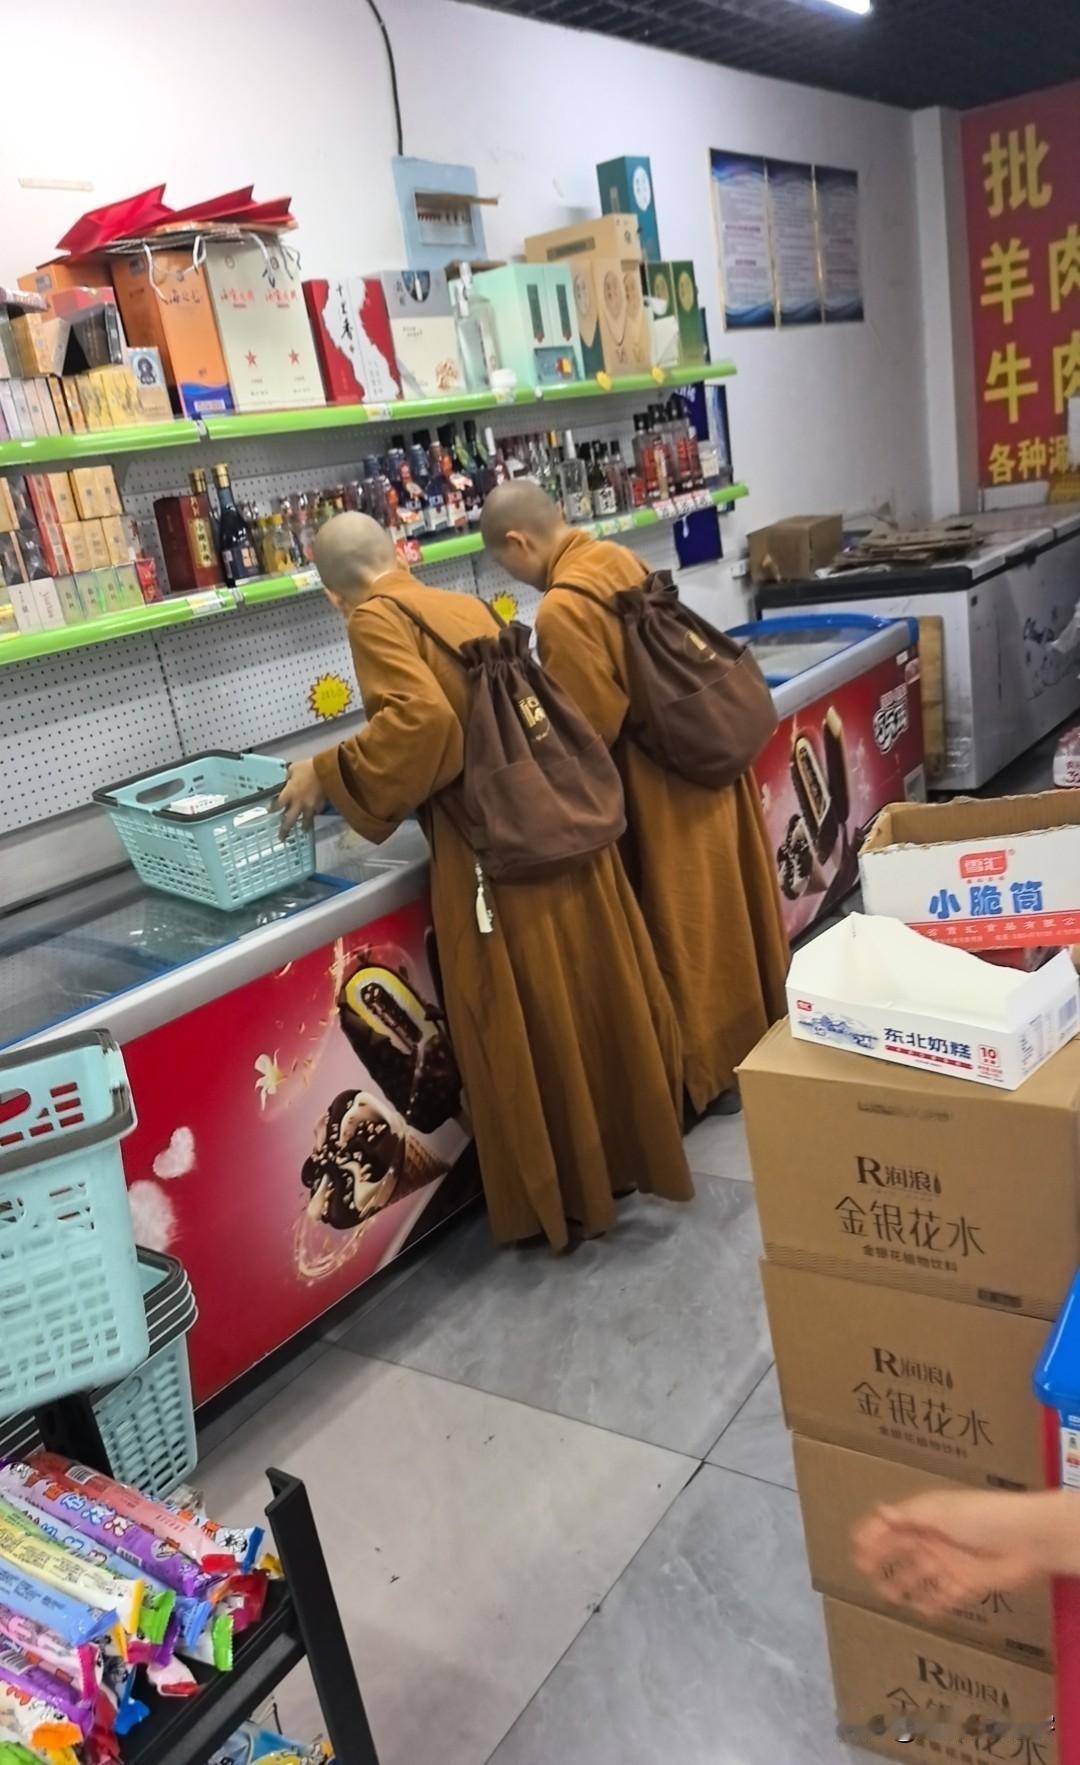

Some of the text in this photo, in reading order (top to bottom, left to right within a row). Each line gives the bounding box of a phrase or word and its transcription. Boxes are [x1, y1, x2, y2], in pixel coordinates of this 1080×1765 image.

[982, 123, 1053, 218] 批
[929, 880, 1043, 919] 小脆筒
[883, 1027, 972, 1060] 东北奶糕
[979, 1046, 997, 1060] 10
[835, 1196, 985, 1257] 金银花水
[852, 1381, 993, 1446] 金银花水
